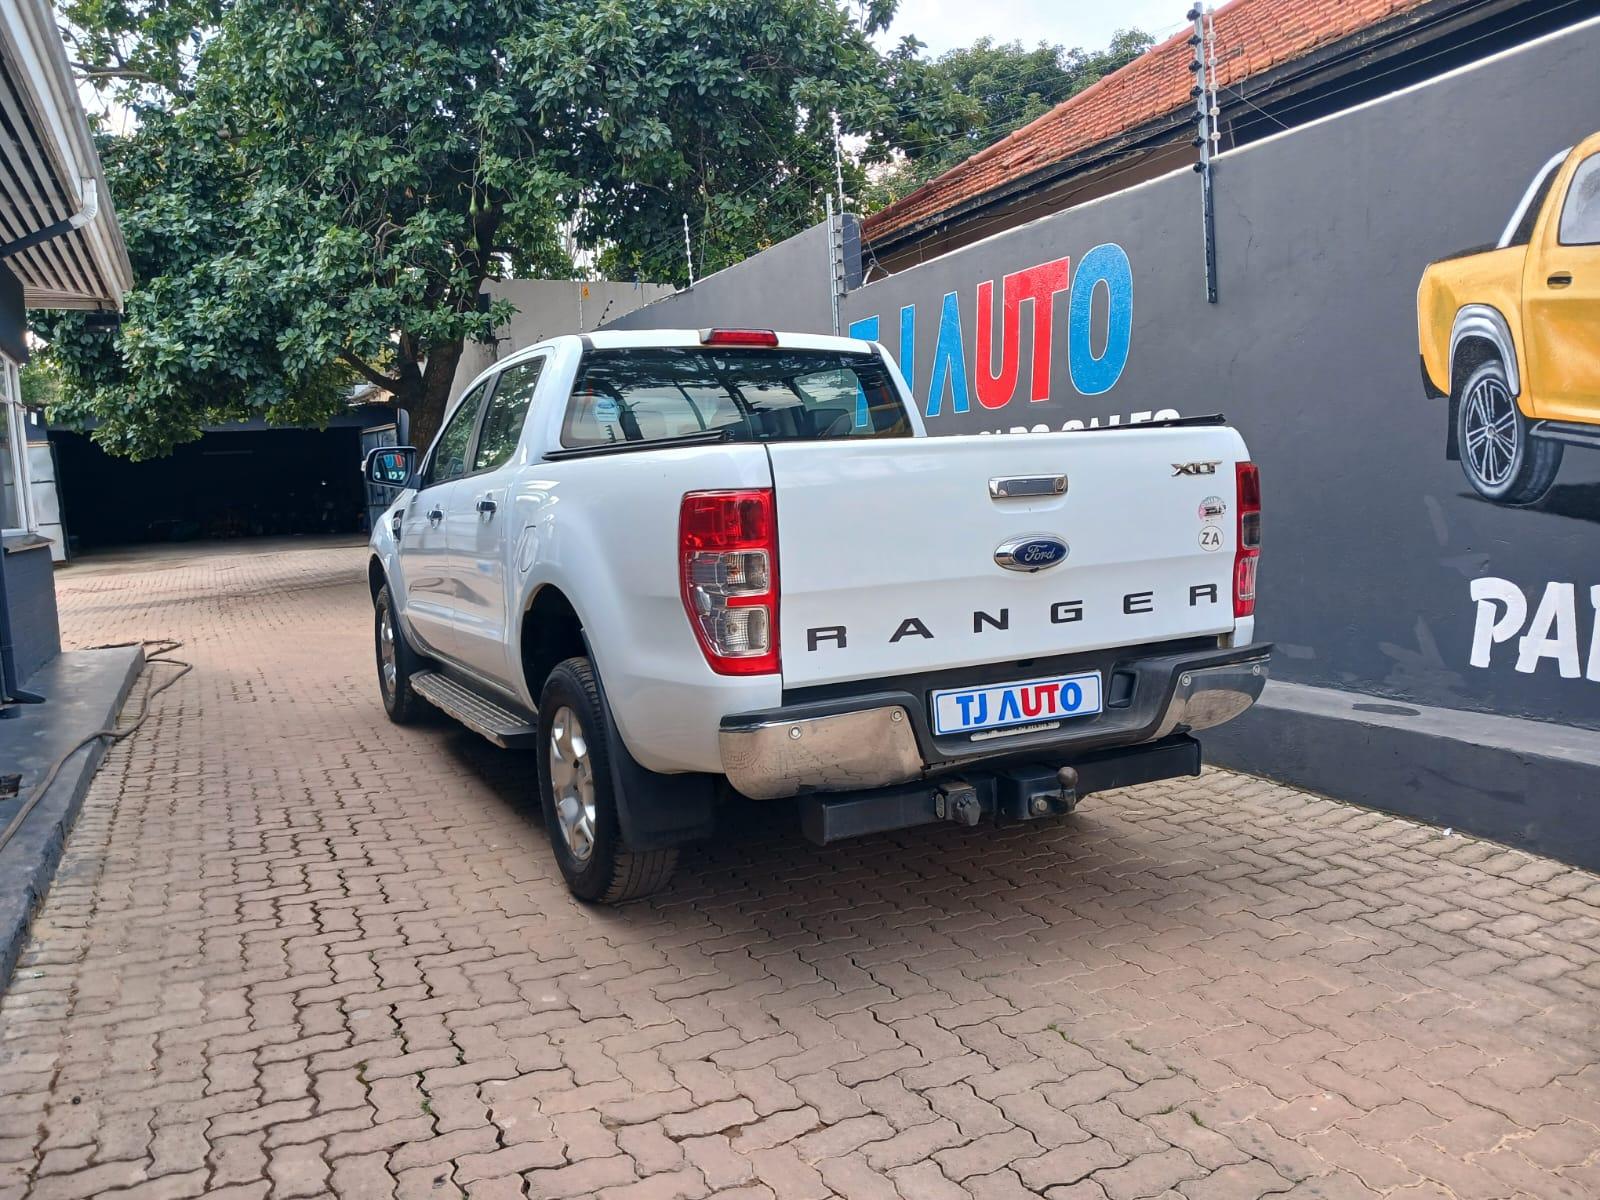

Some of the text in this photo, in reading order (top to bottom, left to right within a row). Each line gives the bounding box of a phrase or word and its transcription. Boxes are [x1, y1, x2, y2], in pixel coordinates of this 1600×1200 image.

[925, 242, 1134, 418] AUTO
[1171, 461, 1222, 477] XLT
[1024, 544, 1056, 562] Ford
[1201, 532, 1220, 545] ZA
[806, 583, 1218, 651] RANGER
[1469, 577, 1600, 683] PA
[955, 682, 1083, 726] TJ AUTO
